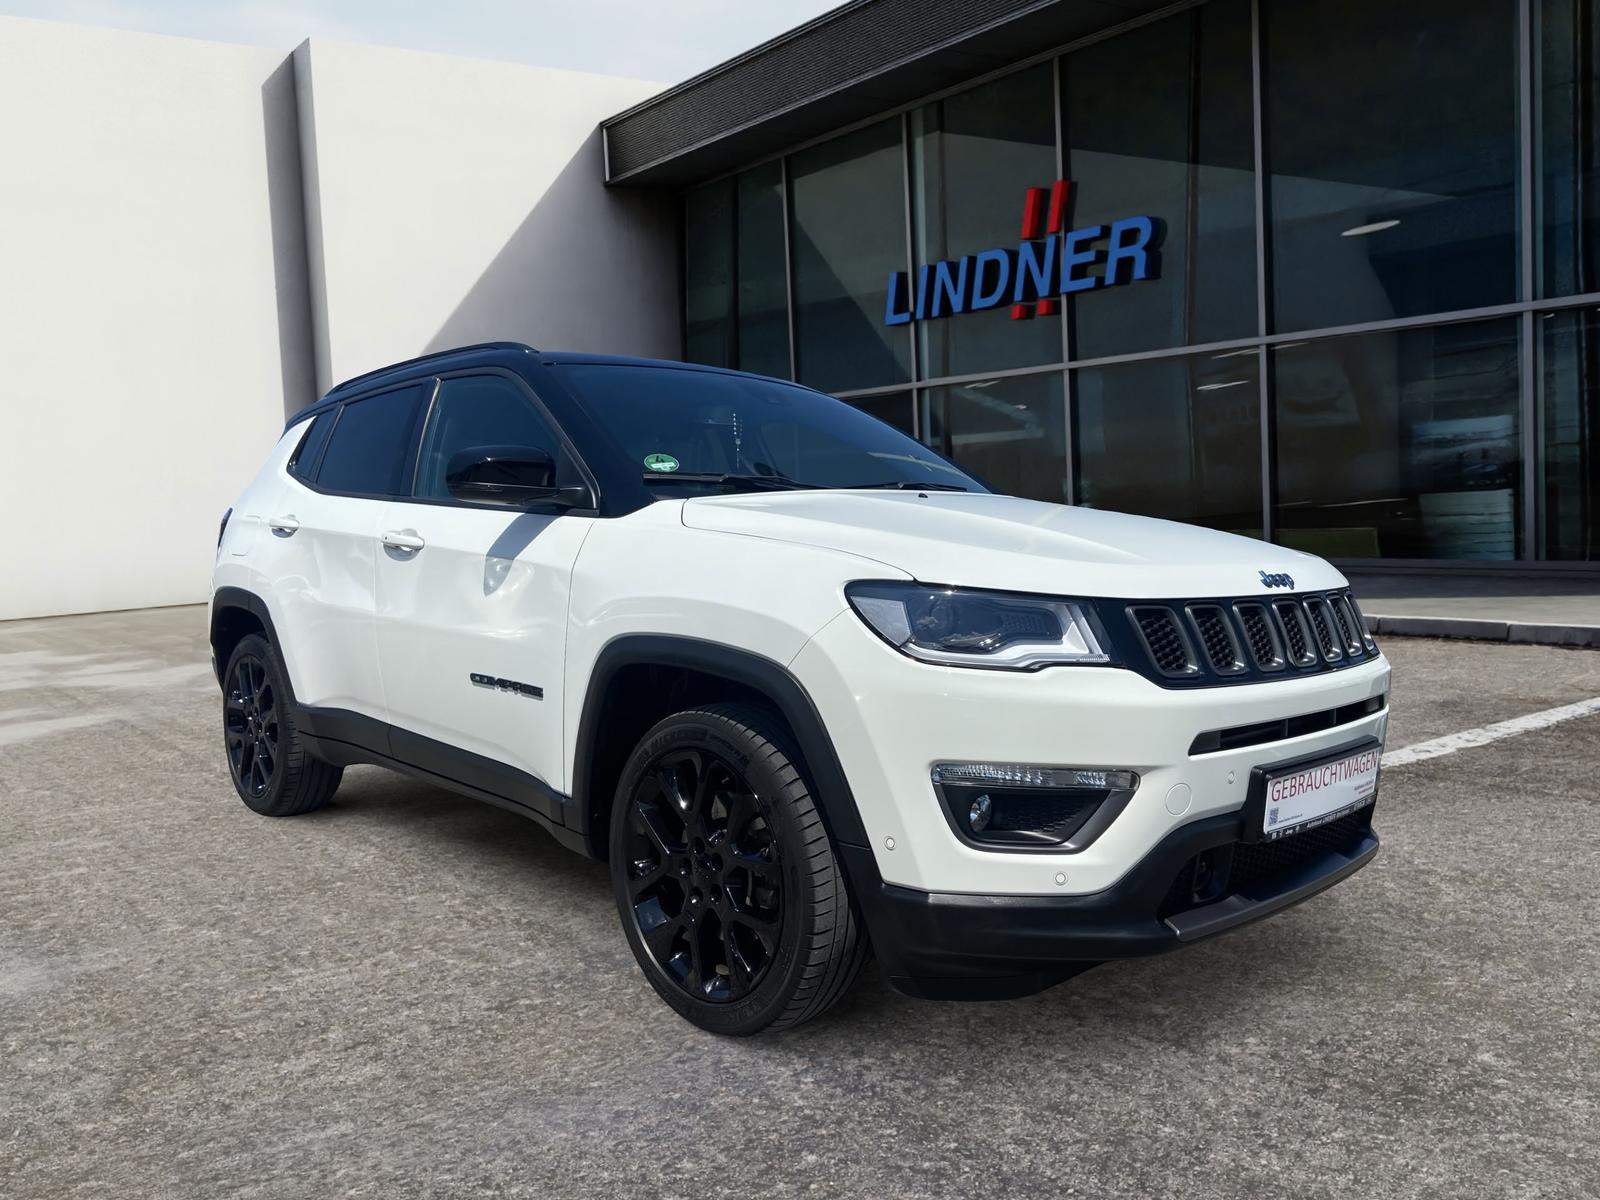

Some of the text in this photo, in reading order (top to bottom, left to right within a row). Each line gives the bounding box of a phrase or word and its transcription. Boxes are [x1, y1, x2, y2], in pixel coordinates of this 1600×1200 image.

[885, 215, 1154, 326] LINDNER
[1258, 570, 1294, 590] Jeep
[1271, 750, 1378, 802] GEBRAUCHTWAGEN
